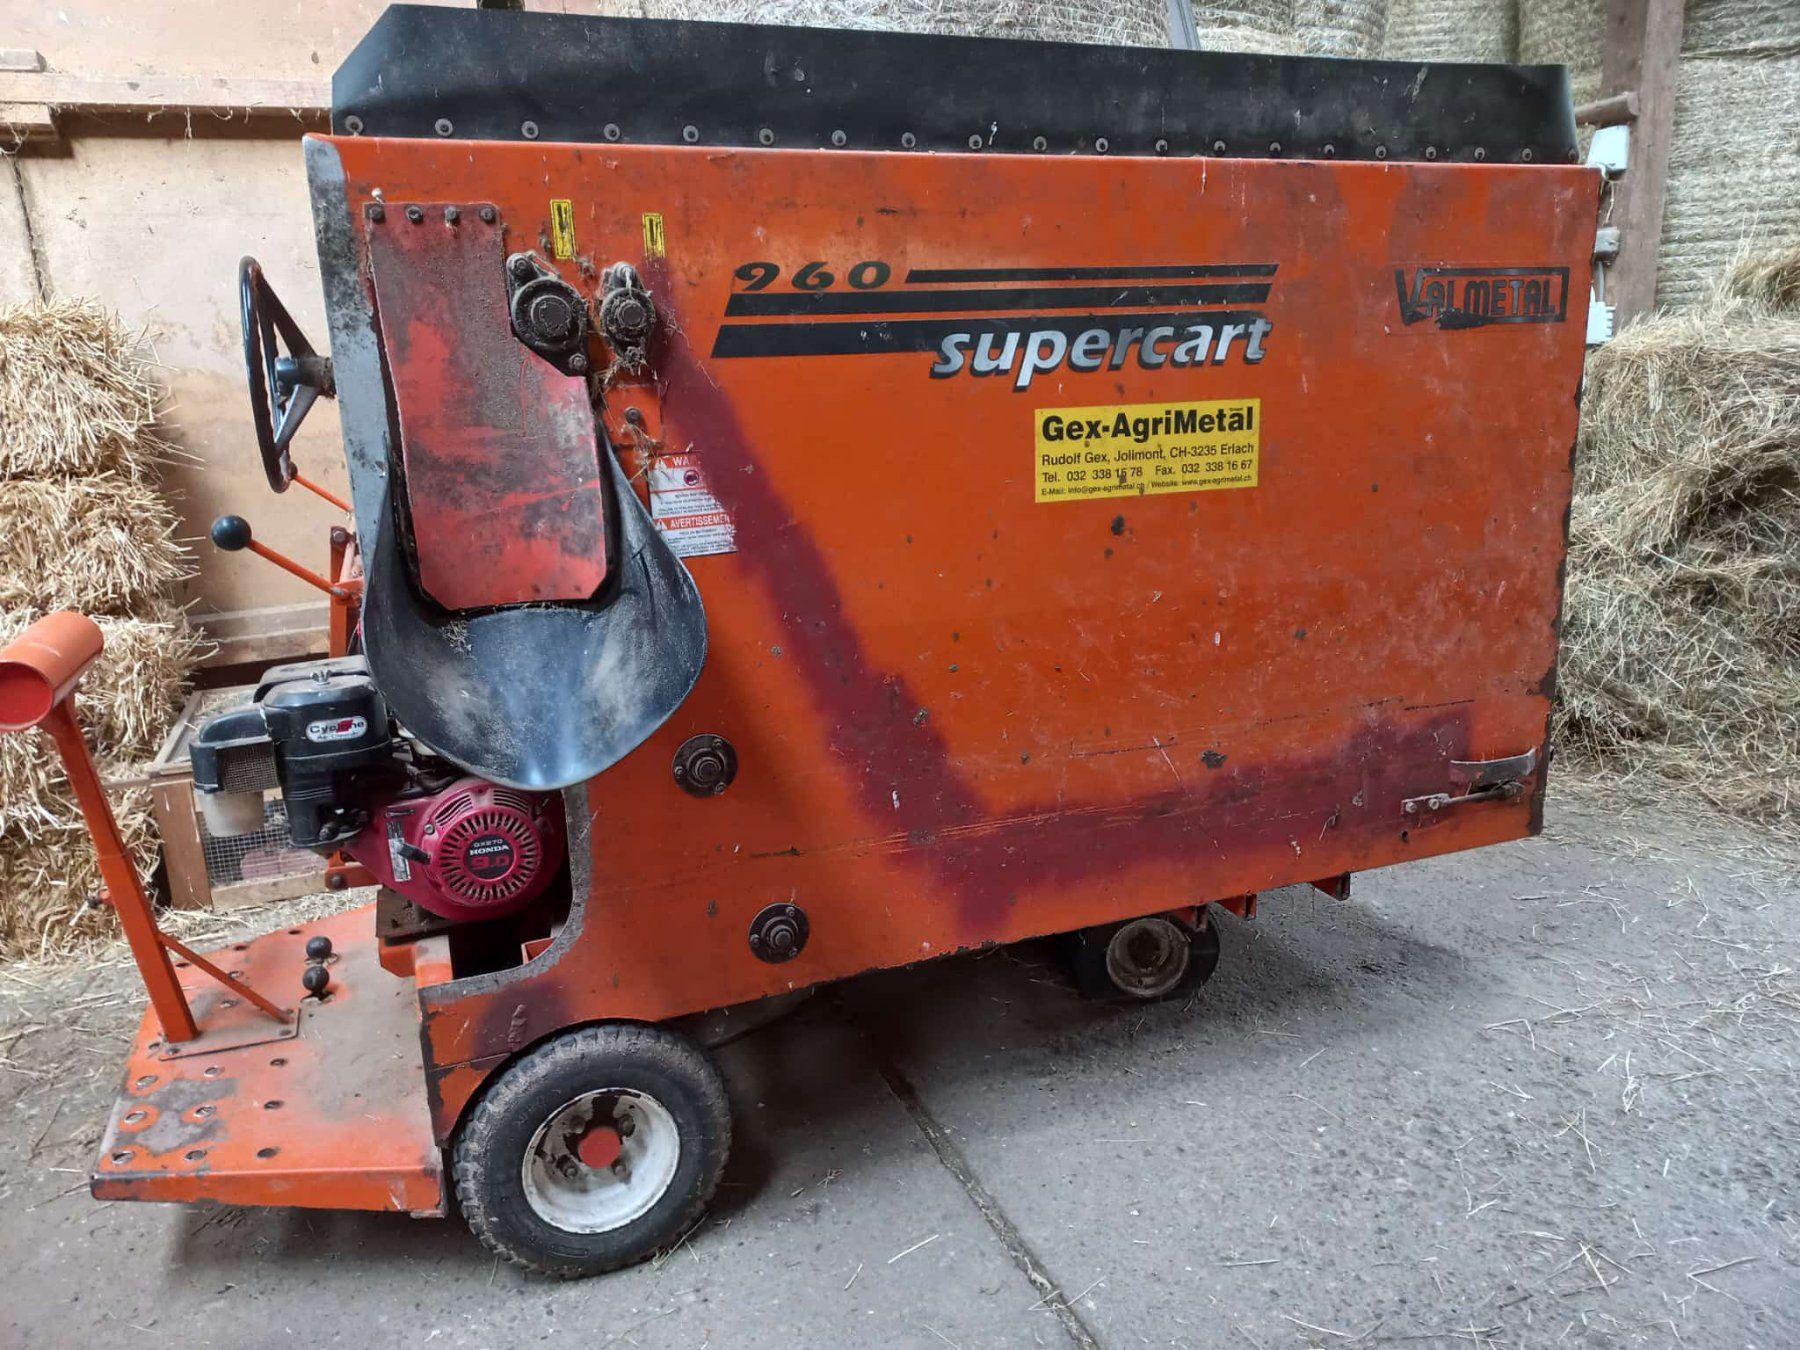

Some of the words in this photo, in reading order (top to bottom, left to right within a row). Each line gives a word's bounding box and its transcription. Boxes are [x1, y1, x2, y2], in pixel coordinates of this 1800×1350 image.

[735, 261, 891, 291] 960
[1395, 267, 1558, 327] VALMETAL
[929, 317, 1272, 392] supercart
[1042, 406, 1254, 443] Gex-AgriMetal
[1042, 452, 1081, 466] Rudolf
[1084, 451, 1110, 465] Gex,
[1114, 448, 1166, 462] Jolimont,
[1169, 445, 1217, 458] CH-3235
[1220, 443, 1254, 455] Erlach
[1042, 472, 1060, 483] Tel.
[1066, 470, 1087, 481] 032
[1092, 468, 1112, 480] 338
[1130, 466, 1143, 477] 78
[1155, 465, 1175, 475] Fax.
[1181, 463, 1200, 474] 032
[1205, 461, 1224, 472] 338
[1227, 460, 1238, 471] 16
[1240, 459, 1252, 470] 67
[469, 845, 510, 856] HONDA
[473, 838, 503, 847] GX270
